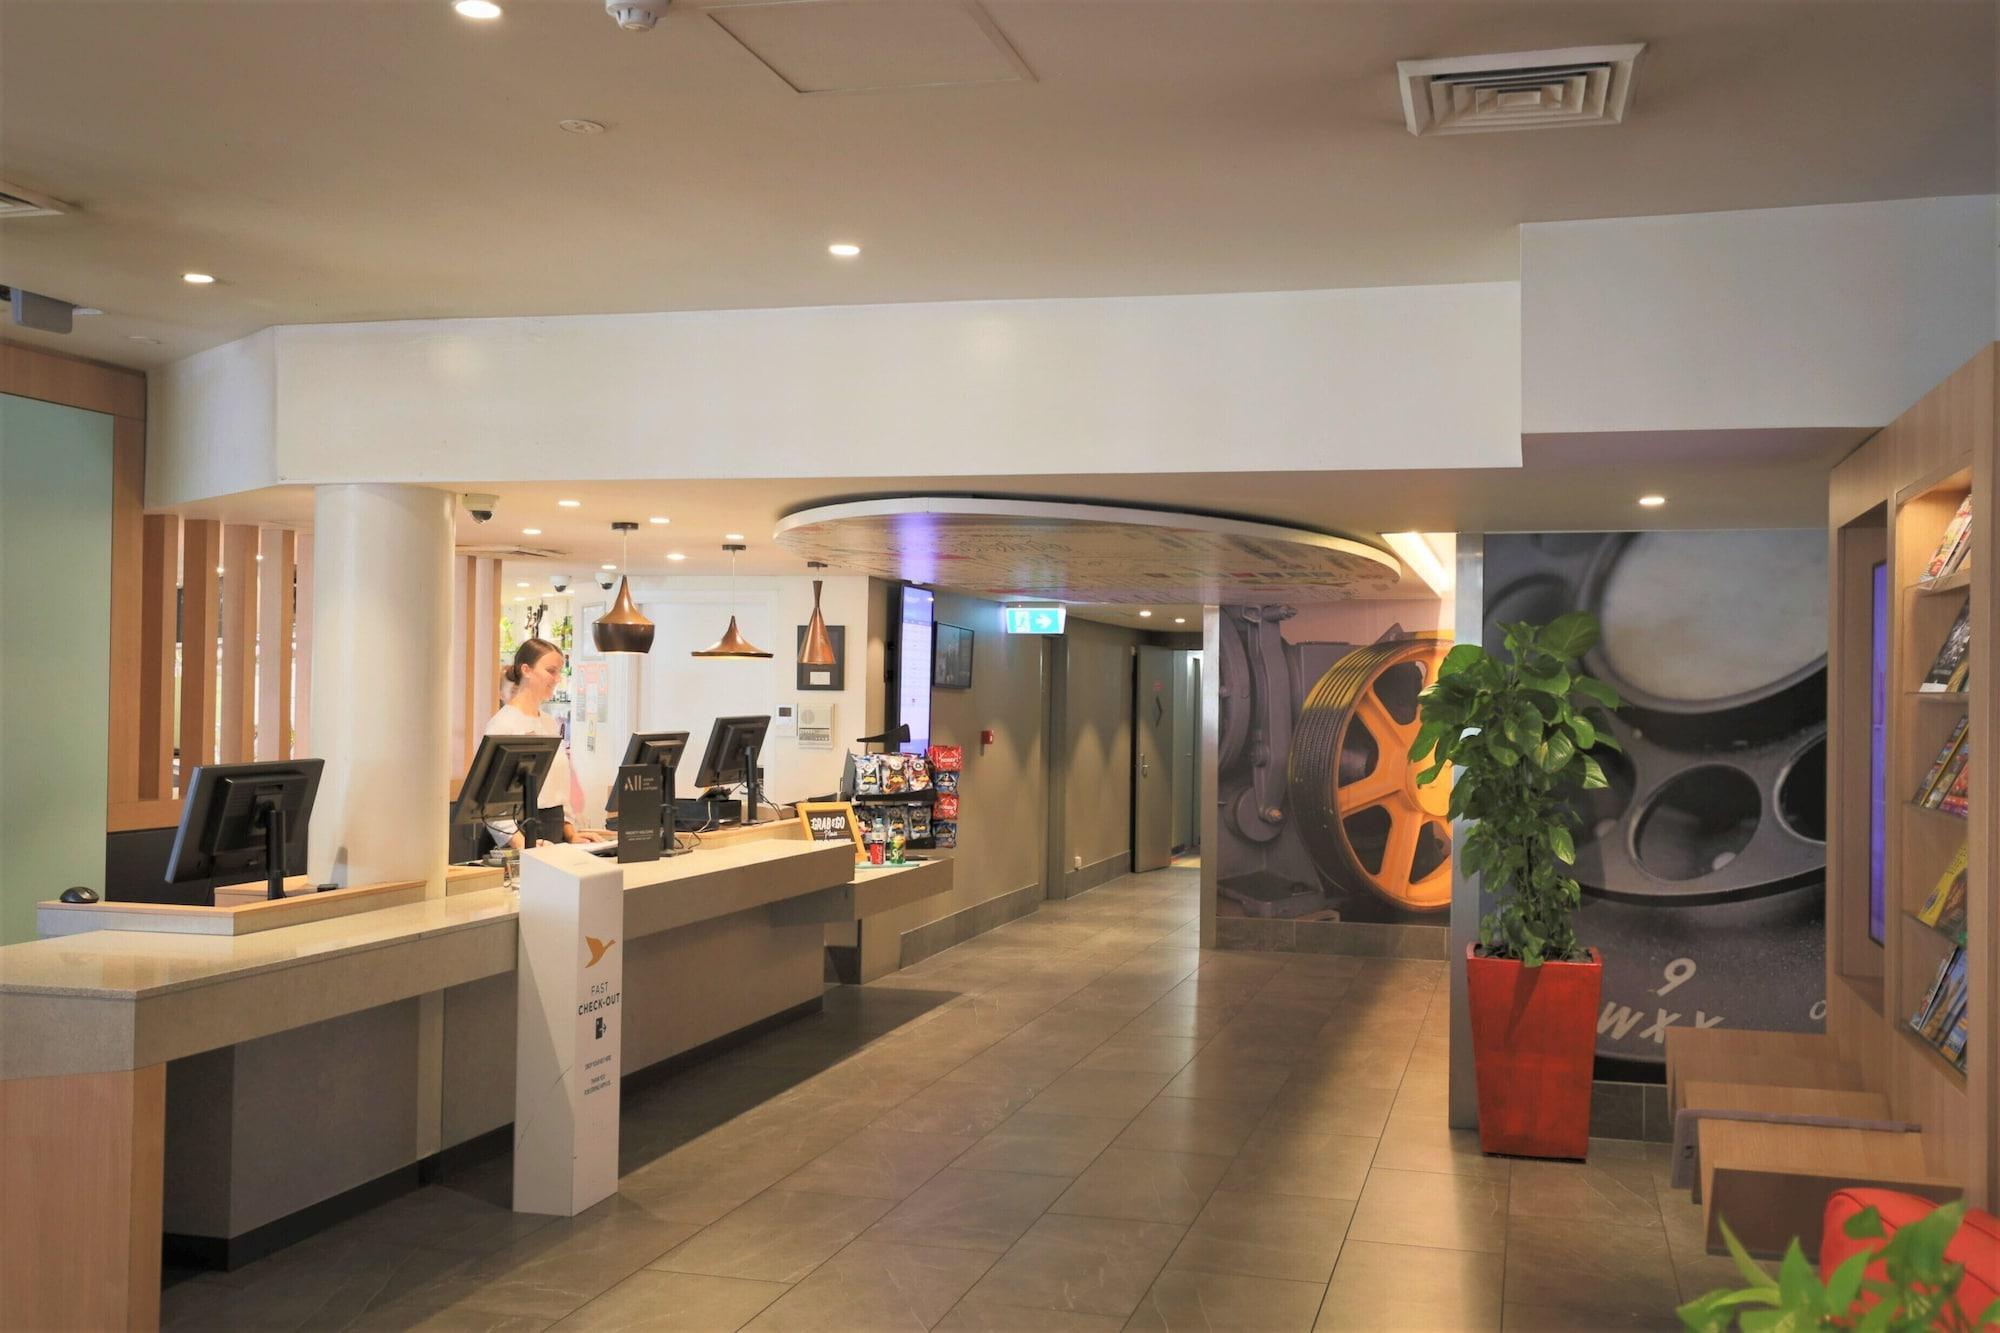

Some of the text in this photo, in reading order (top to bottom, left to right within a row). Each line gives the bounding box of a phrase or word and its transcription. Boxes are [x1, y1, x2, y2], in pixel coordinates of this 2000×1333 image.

[591, 981, 608, 994] FAST
[1655, 957, 1697, 997] 9
[578, 992, 620, 1014] CHECK-OUT
